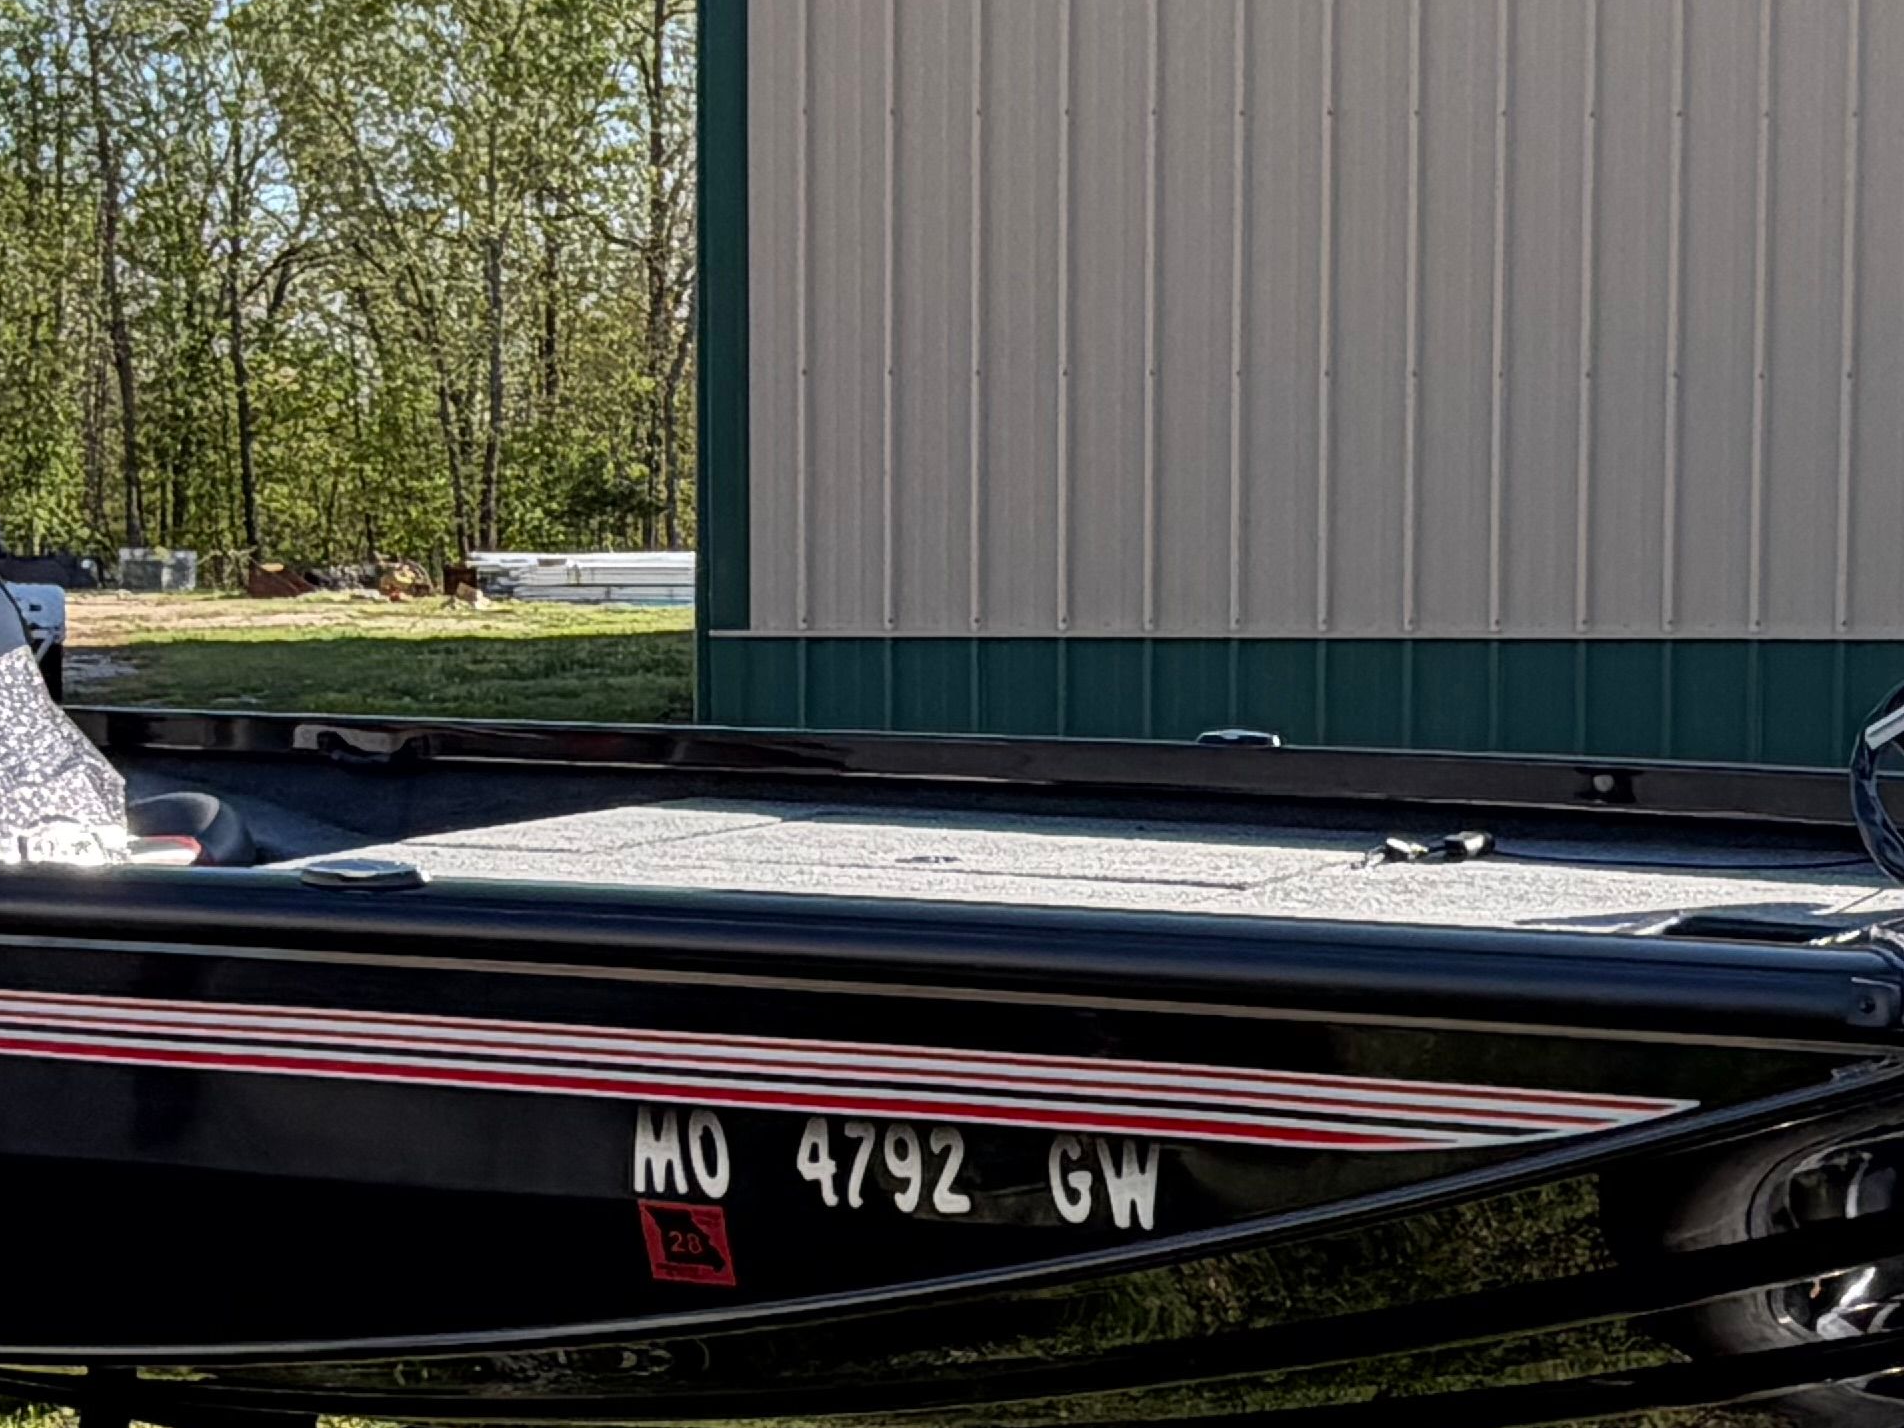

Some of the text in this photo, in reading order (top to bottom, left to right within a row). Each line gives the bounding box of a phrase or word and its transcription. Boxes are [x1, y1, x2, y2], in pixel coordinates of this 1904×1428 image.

[633, 1104, 1160, 1231] MO 4792 GW
[667, 1229, 703, 1255] 28
